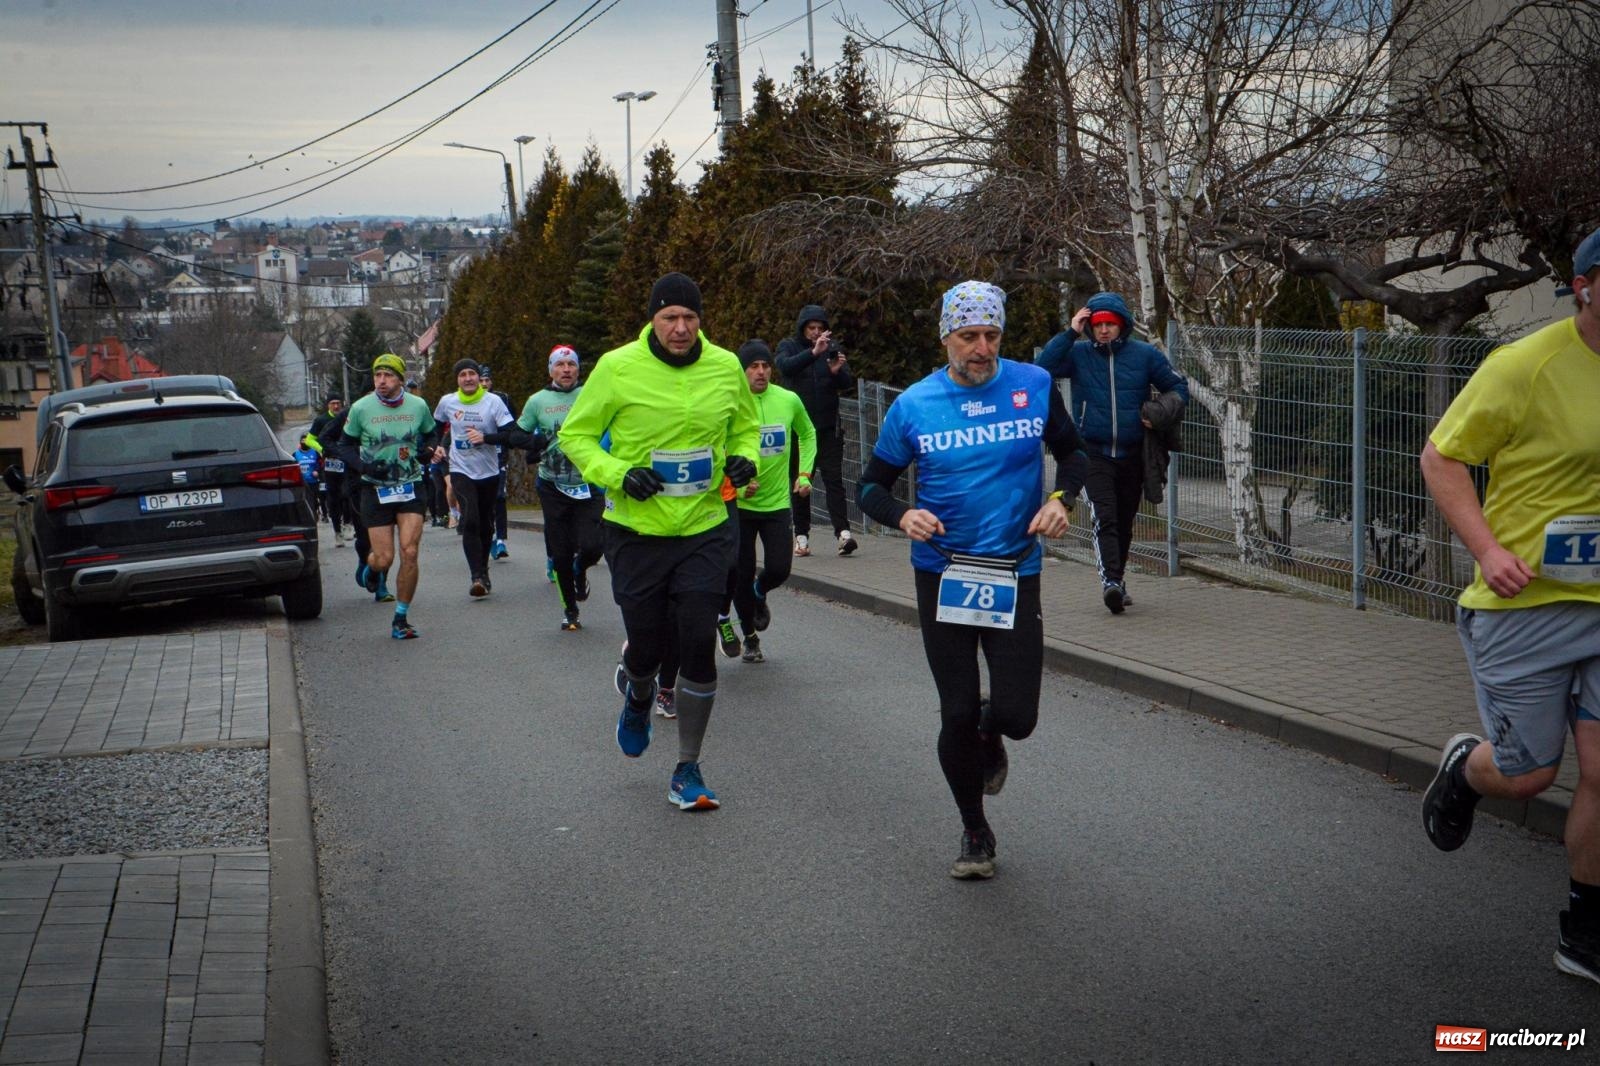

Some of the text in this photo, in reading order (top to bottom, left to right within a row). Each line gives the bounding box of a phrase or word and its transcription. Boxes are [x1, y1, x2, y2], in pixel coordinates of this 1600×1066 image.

[918, 417, 1044, 453] RUNNERS
[677, 463, 690, 482] 5
[149, 495, 168, 509] OP
[175, 490, 218, 506] 1239P
[961, 582, 995, 609] 78
